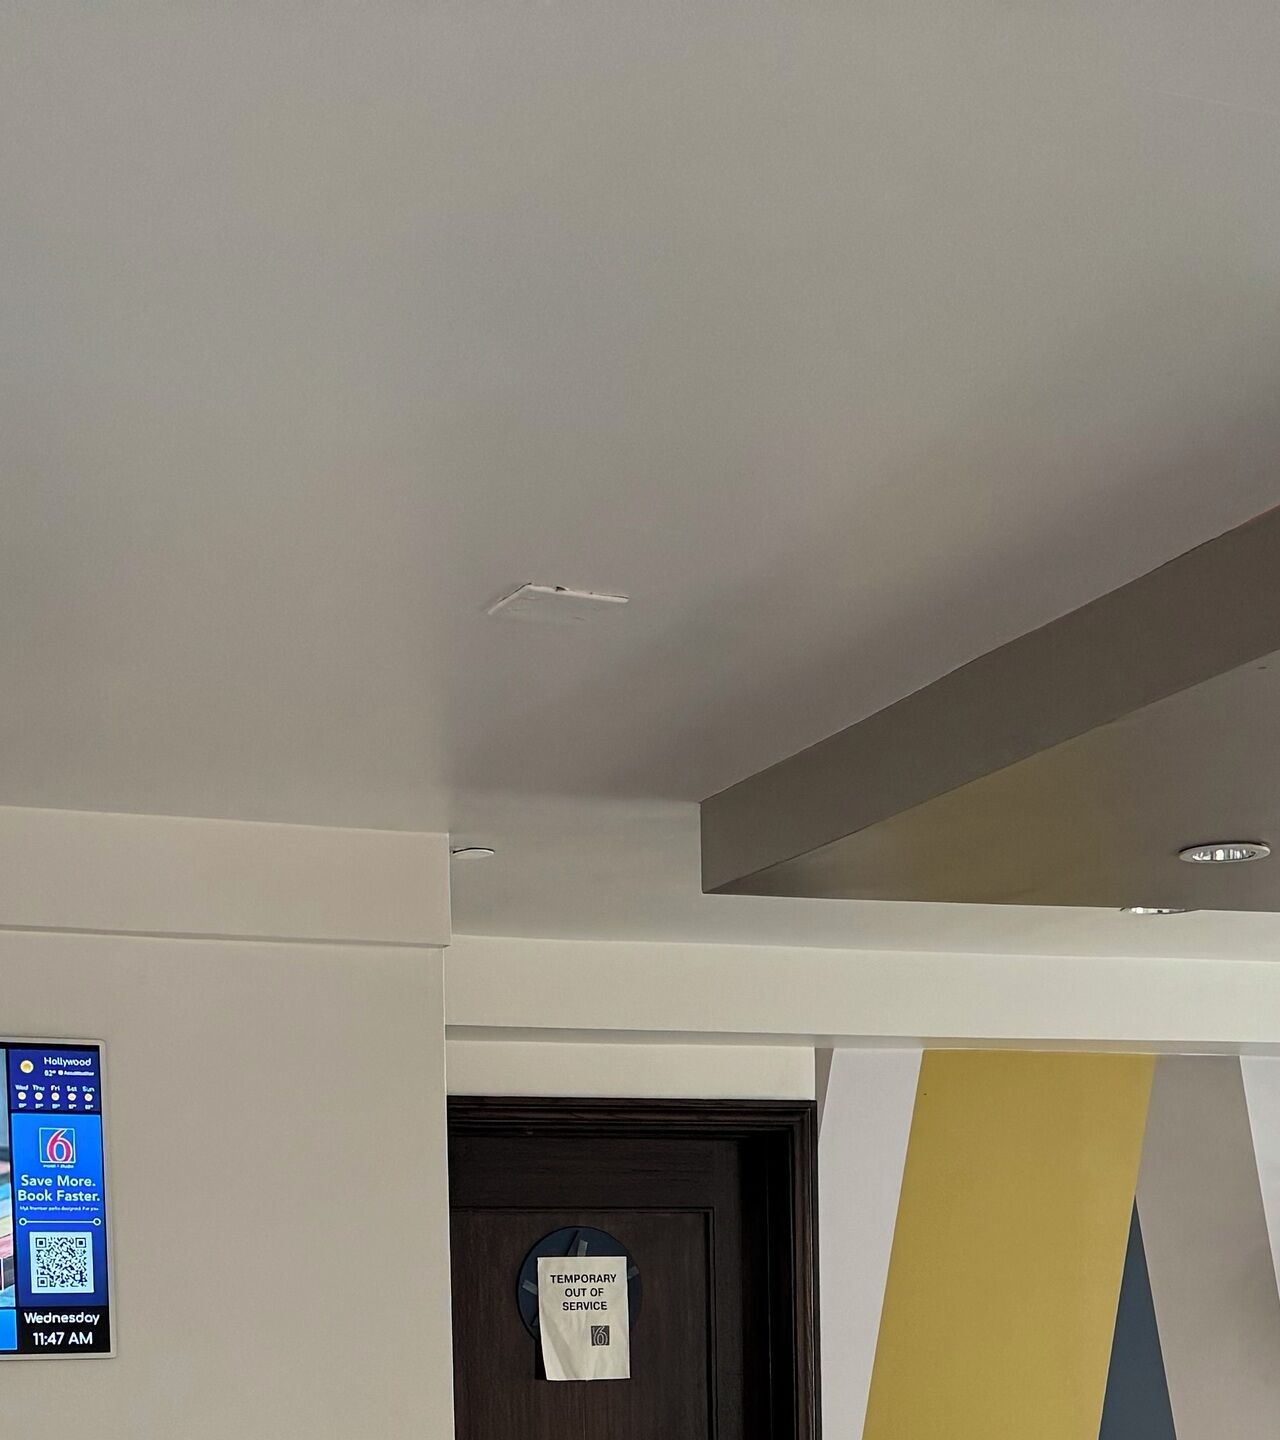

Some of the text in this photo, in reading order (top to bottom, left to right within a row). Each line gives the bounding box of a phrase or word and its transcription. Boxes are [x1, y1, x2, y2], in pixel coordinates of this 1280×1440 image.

[43, 1057, 92, 1067] Hollywood
[46, 1127, 73, 1164] 6
[21, 1174, 96, 1187] Save More.
[17, 1189, 100, 1201] Book Faster.
[550, 1274, 617, 1283] TEMPORARY
[564, 1288, 604, 1297] OUT OF
[562, 1301, 608, 1311] SERVICE
[24, 1312, 100, 1325] Wednesday
[33, 1331, 93, 1346] 11:47 AM
